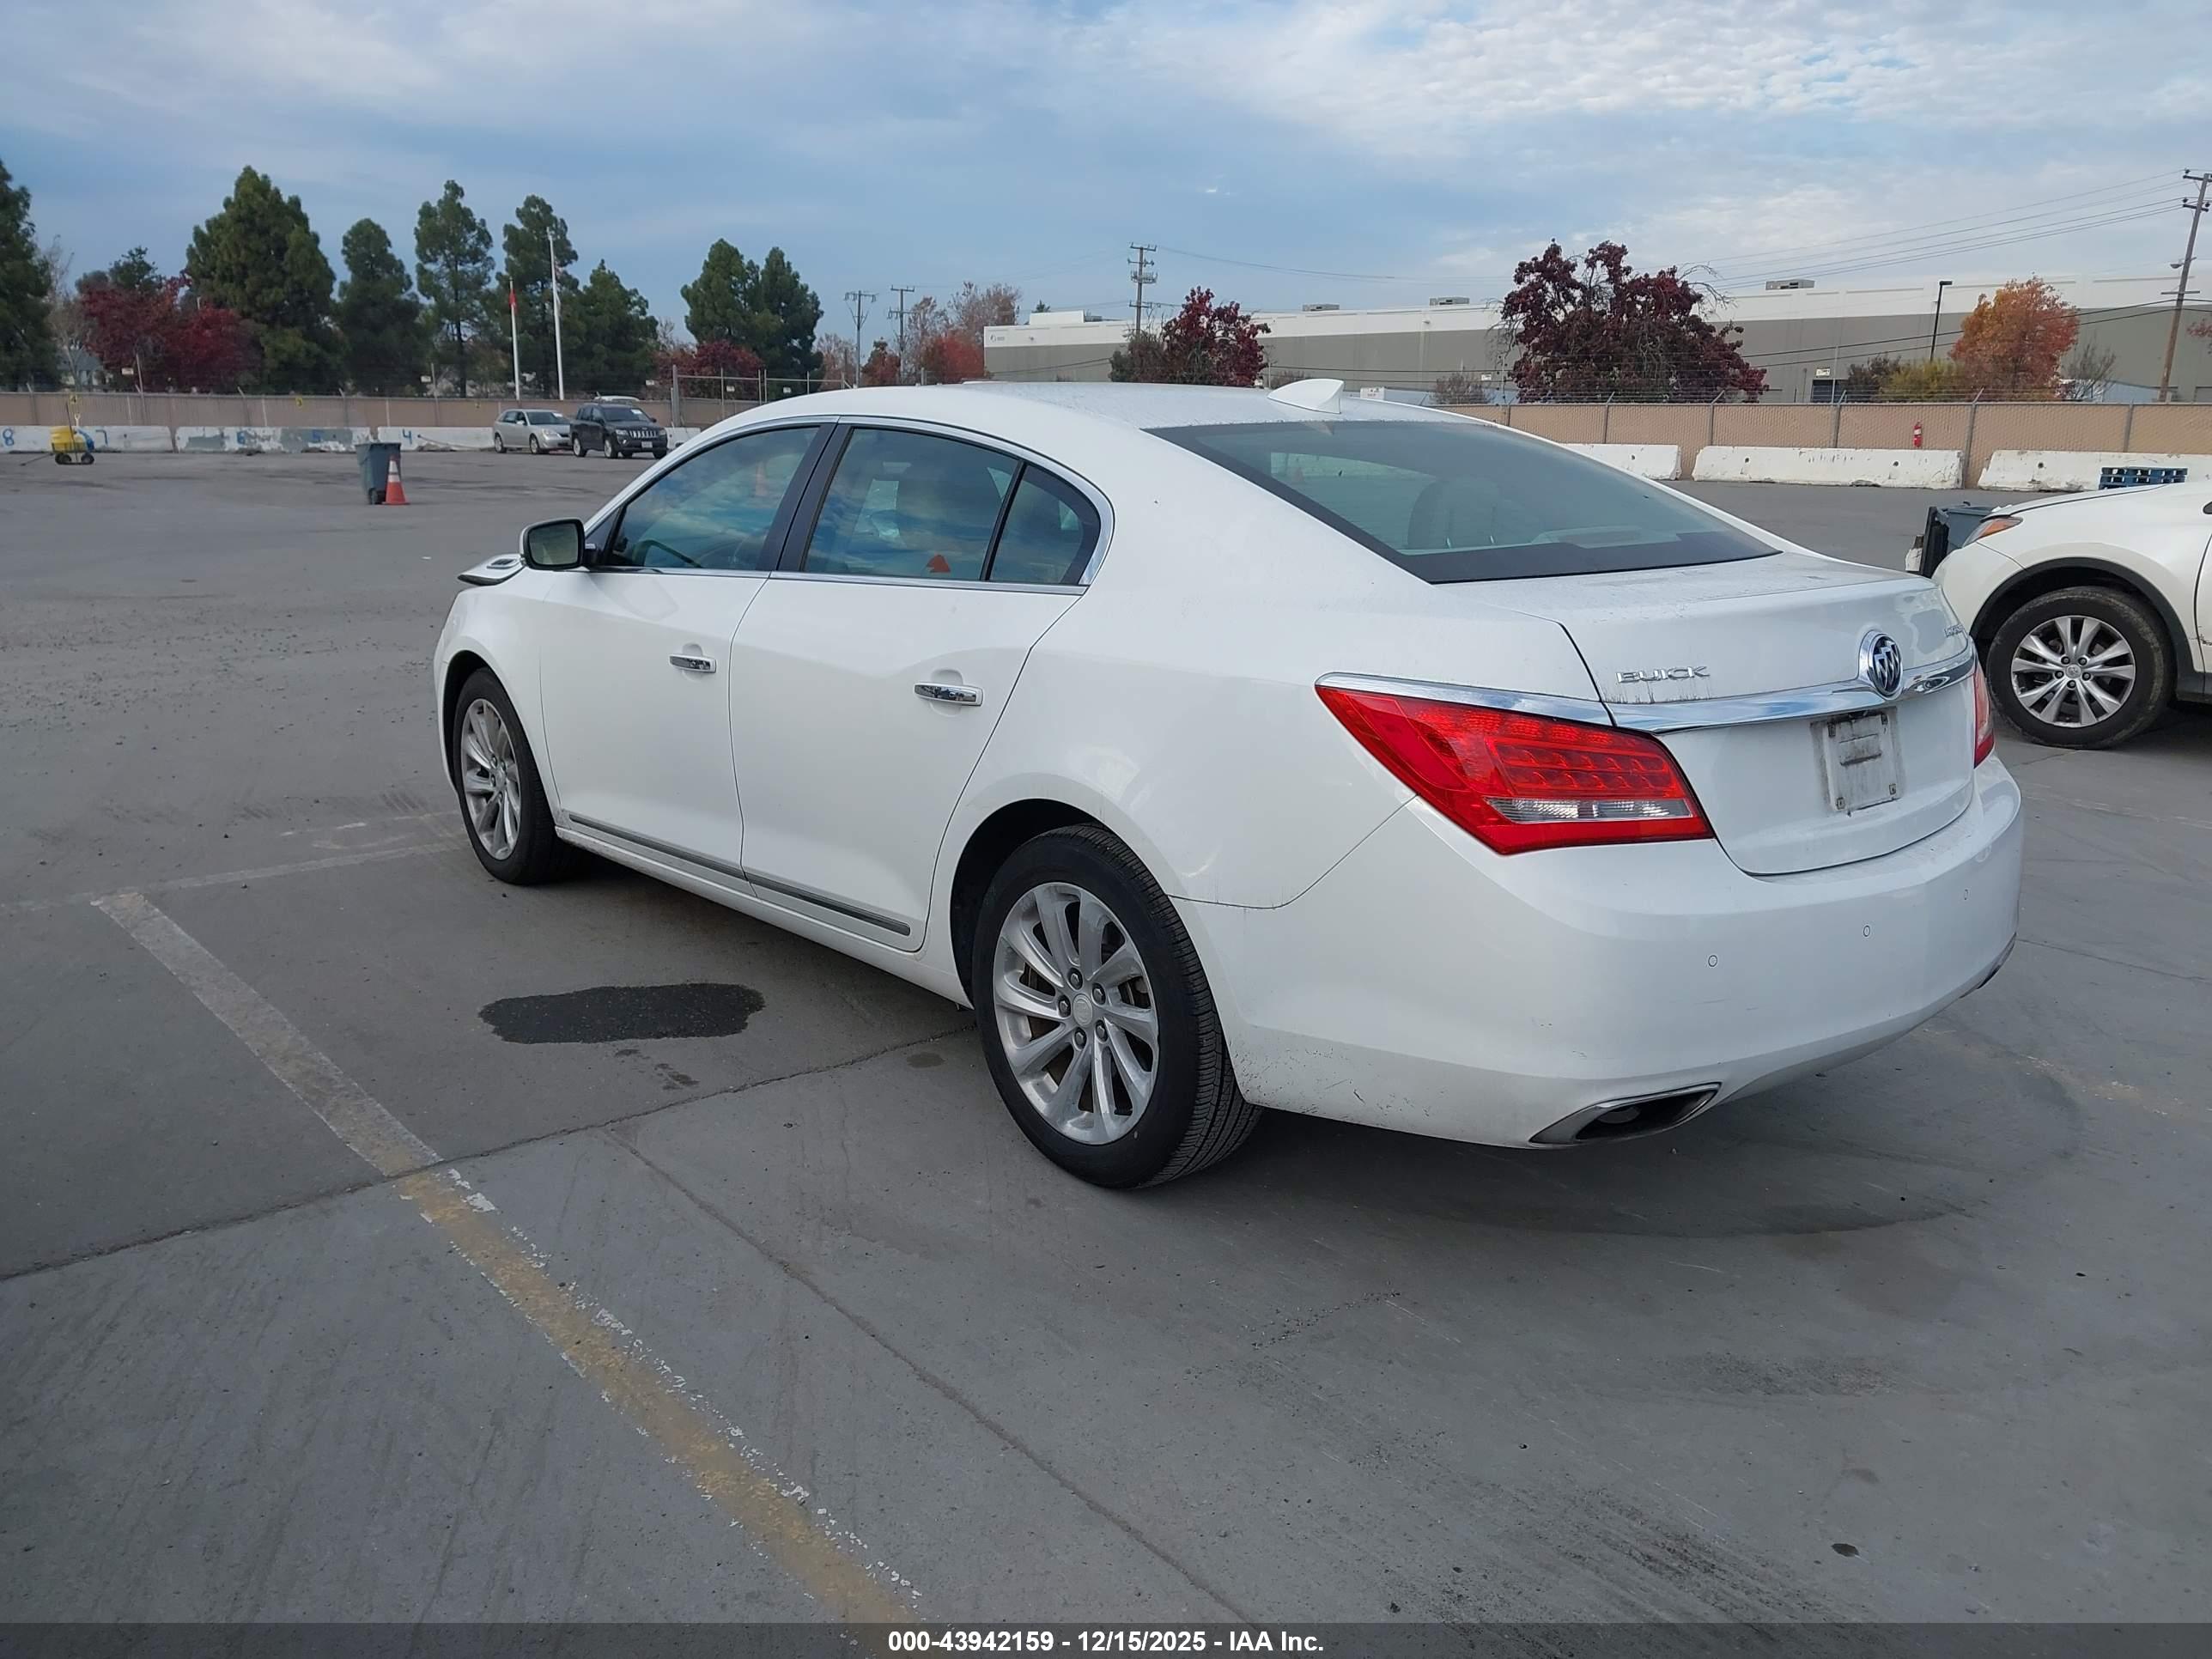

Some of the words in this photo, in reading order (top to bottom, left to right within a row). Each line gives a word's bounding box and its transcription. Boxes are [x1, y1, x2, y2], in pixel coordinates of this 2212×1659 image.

[3, 429, 15, 446] 8
[402, 428, 413, 445] 4
[1615, 665, 1711, 684] BUICK
